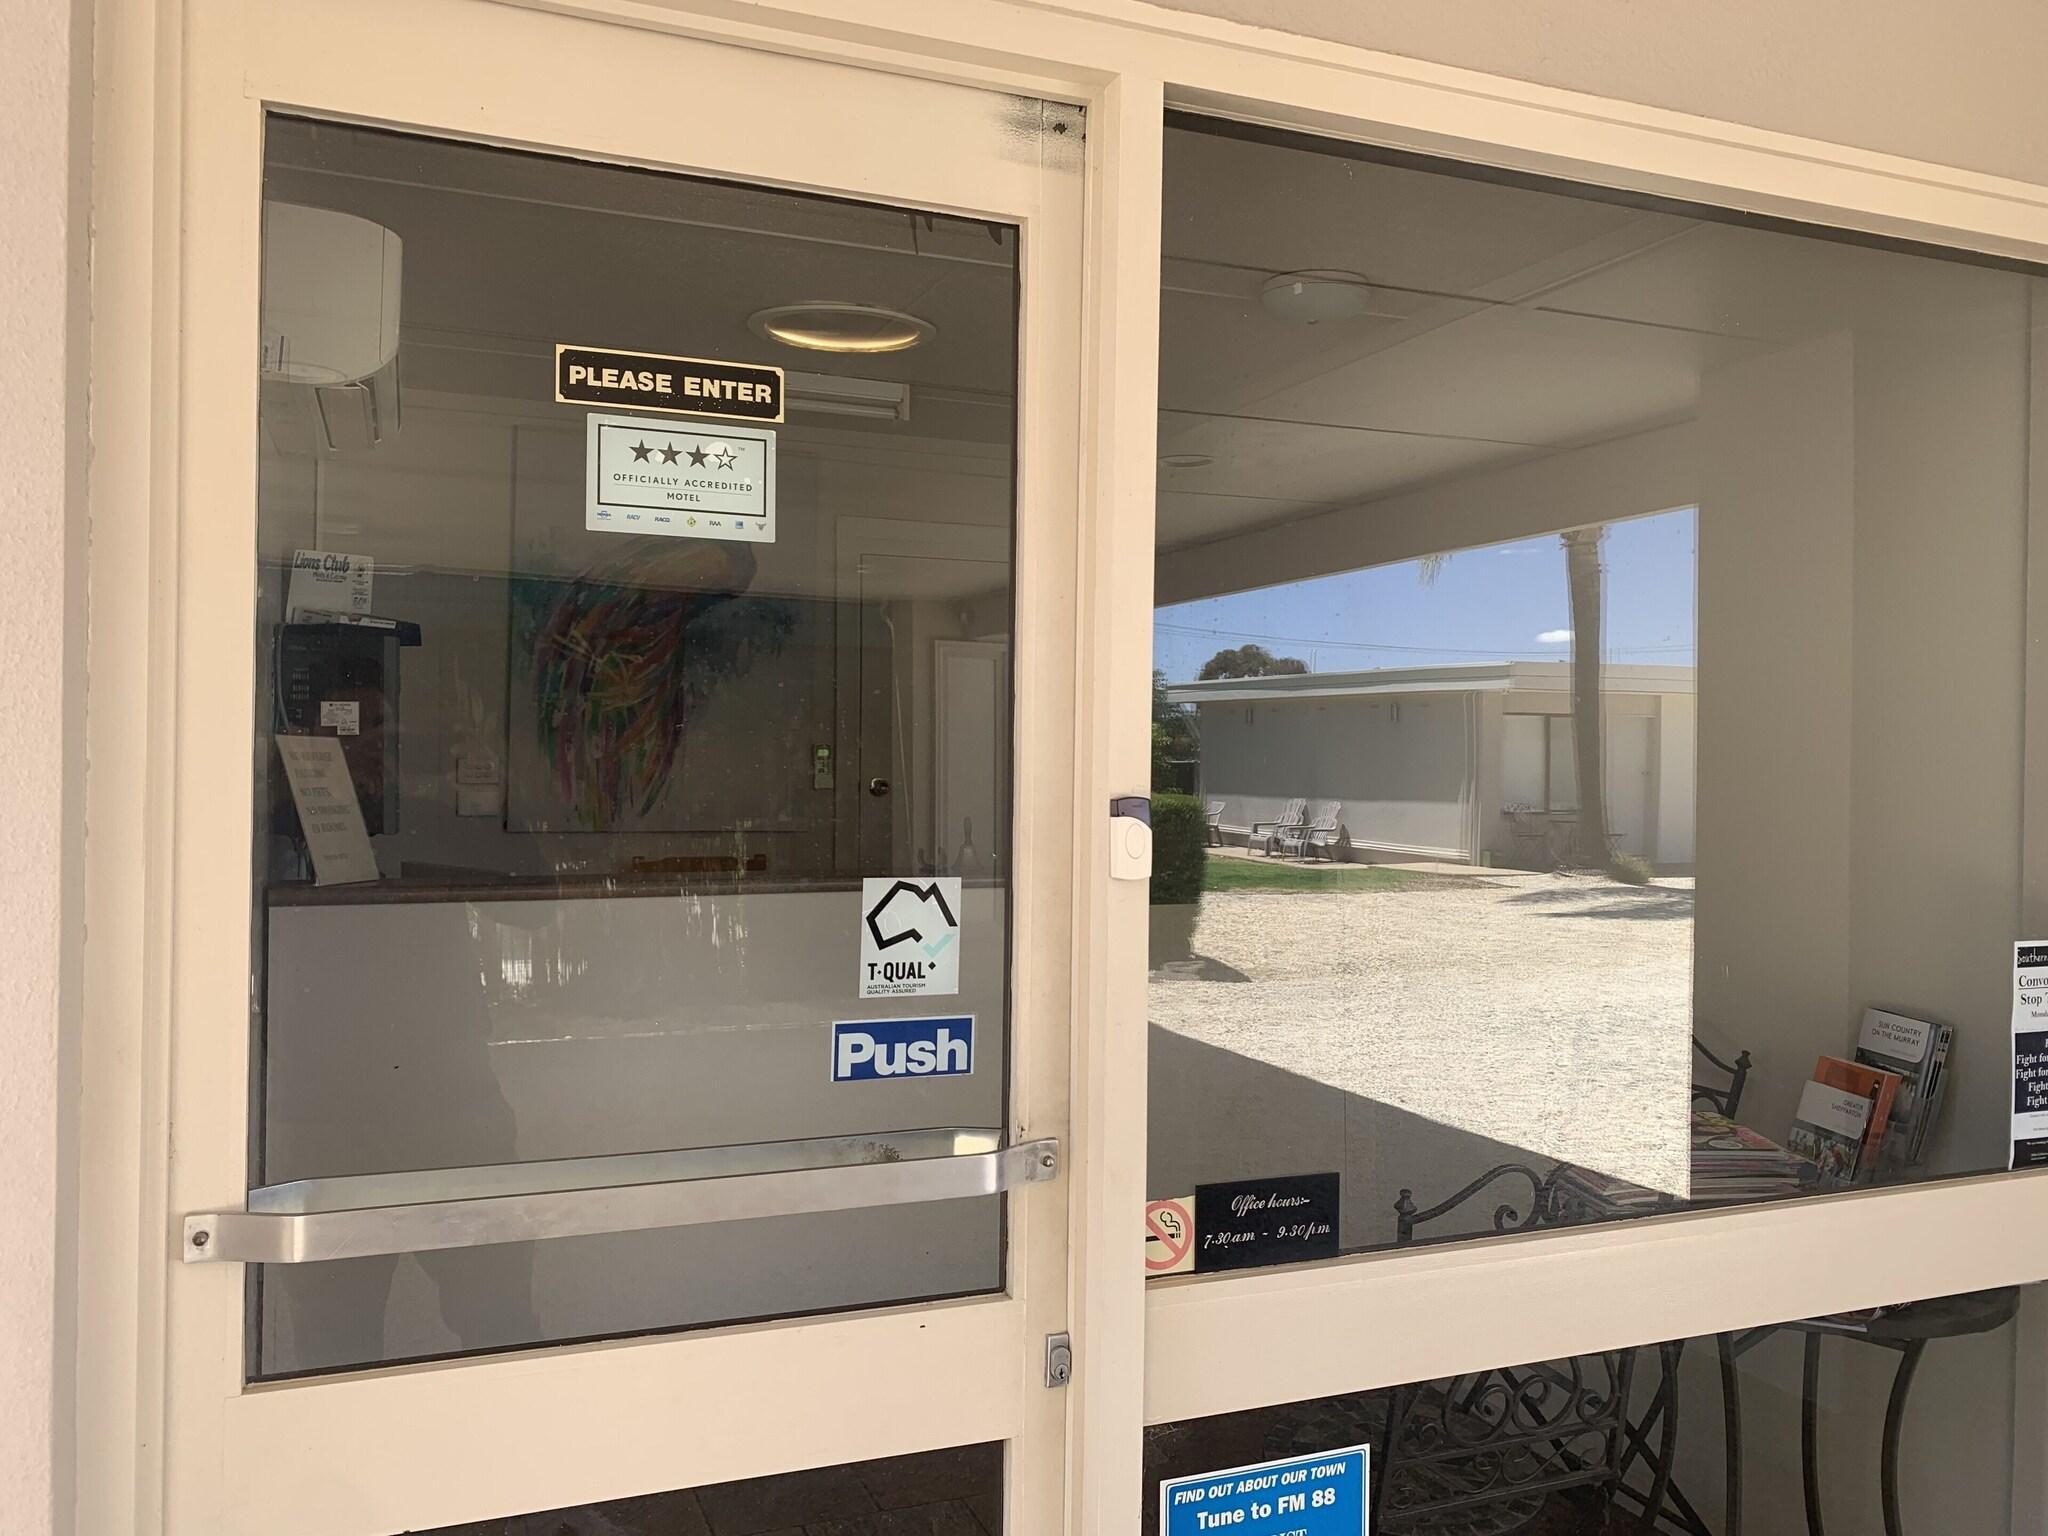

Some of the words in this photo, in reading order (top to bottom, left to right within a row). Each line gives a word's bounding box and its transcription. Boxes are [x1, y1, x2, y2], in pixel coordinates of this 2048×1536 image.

[569, 365, 672, 394] PLEASE
[684, 376, 772, 403] ENTER
[613, 473, 679, 486] OFFICIALLY
[684, 478, 753, 492] ACCREDITED
[666, 492, 701, 502] MOTEL
[294, 552, 321, 569] Lions
[323, 554, 350, 573] Club
[2020, 993, 2043, 1007] Stop
[1871, 1028, 1880, 1036] ON
[1882, 1031, 1892, 1040] THE
[1893, 1034, 1920, 1047] MURRAY
[1891, 1024, 1922, 1037] COUNTRY
[838, 1029, 968, 1078] Push
[2016, 1053, 2037, 1067] Fight
[2016, 1067, 2036, 1081] Fight
[2027, 1095, 2048, 1109] Fight
[1231, 1195, 1266, 1217] Office
[1174, 1488, 1205, 1506] FIND
[1208, 1483, 1234, 1499] OUT
[1236, 1475, 1279, 1494] ABOUT
[1280, 1468, 1307, 1485] OUR
[1310, 1462, 1346, 1480] TOWN
[1197, 1509, 1245, 1530] Tune
[1250, 1502, 1271, 1520] to
[1278, 1493, 1305, 1515] FM
[1311, 1487, 1336, 1507] 88
